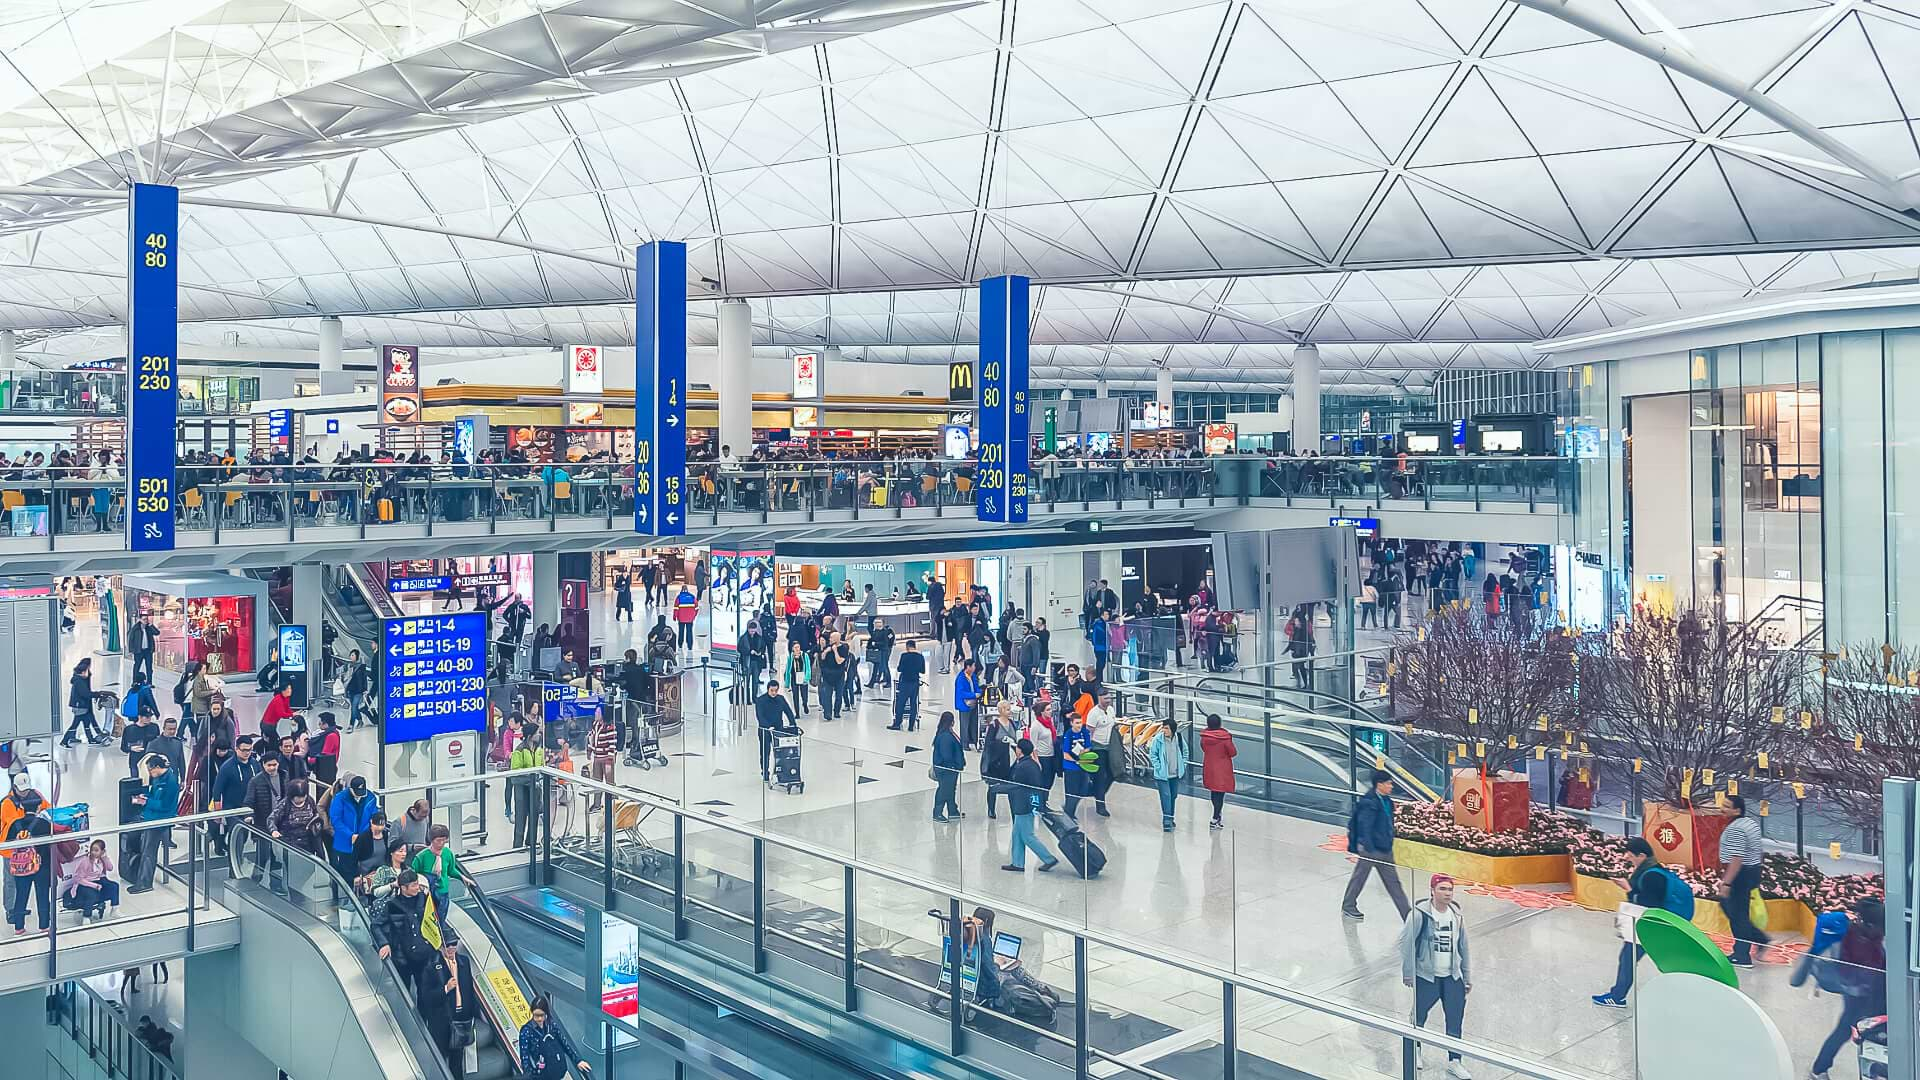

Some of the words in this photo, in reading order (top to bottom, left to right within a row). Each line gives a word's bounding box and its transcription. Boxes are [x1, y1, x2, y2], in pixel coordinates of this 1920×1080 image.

[145, 233, 167, 249] 40
[145, 251, 167, 268] 80
[141, 356, 169, 371] 201
[984, 362, 999, 381] 40
[139, 374, 170, 390] 230
[670, 378, 676, 393] 1
[669, 394, 677, 406] 4
[984, 388, 999, 407] 80
[1015, 392, 1024, 402] 40
[1015, 403, 1024, 414] 80
[637, 440, 649, 464] 20
[981, 443, 1002, 463] 201
[139, 478, 168, 494] 501
[637, 471, 649, 495] 36
[665, 476, 679, 489] 15
[979, 469, 1003, 489] 230
[1012, 473, 1026, 484] 201
[665, 492, 679, 505] 19
[1011, 486, 1026, 497] 230
[137, 496, 169, 512] 530
[435, 618, 456, 633] 1-4
[435, 637, 471, 653] 15-19
[435, 657, 474, 673] 40-80
[434, 676, 485, 695] 201-230
[435, 696, 485, 715] 501-530
